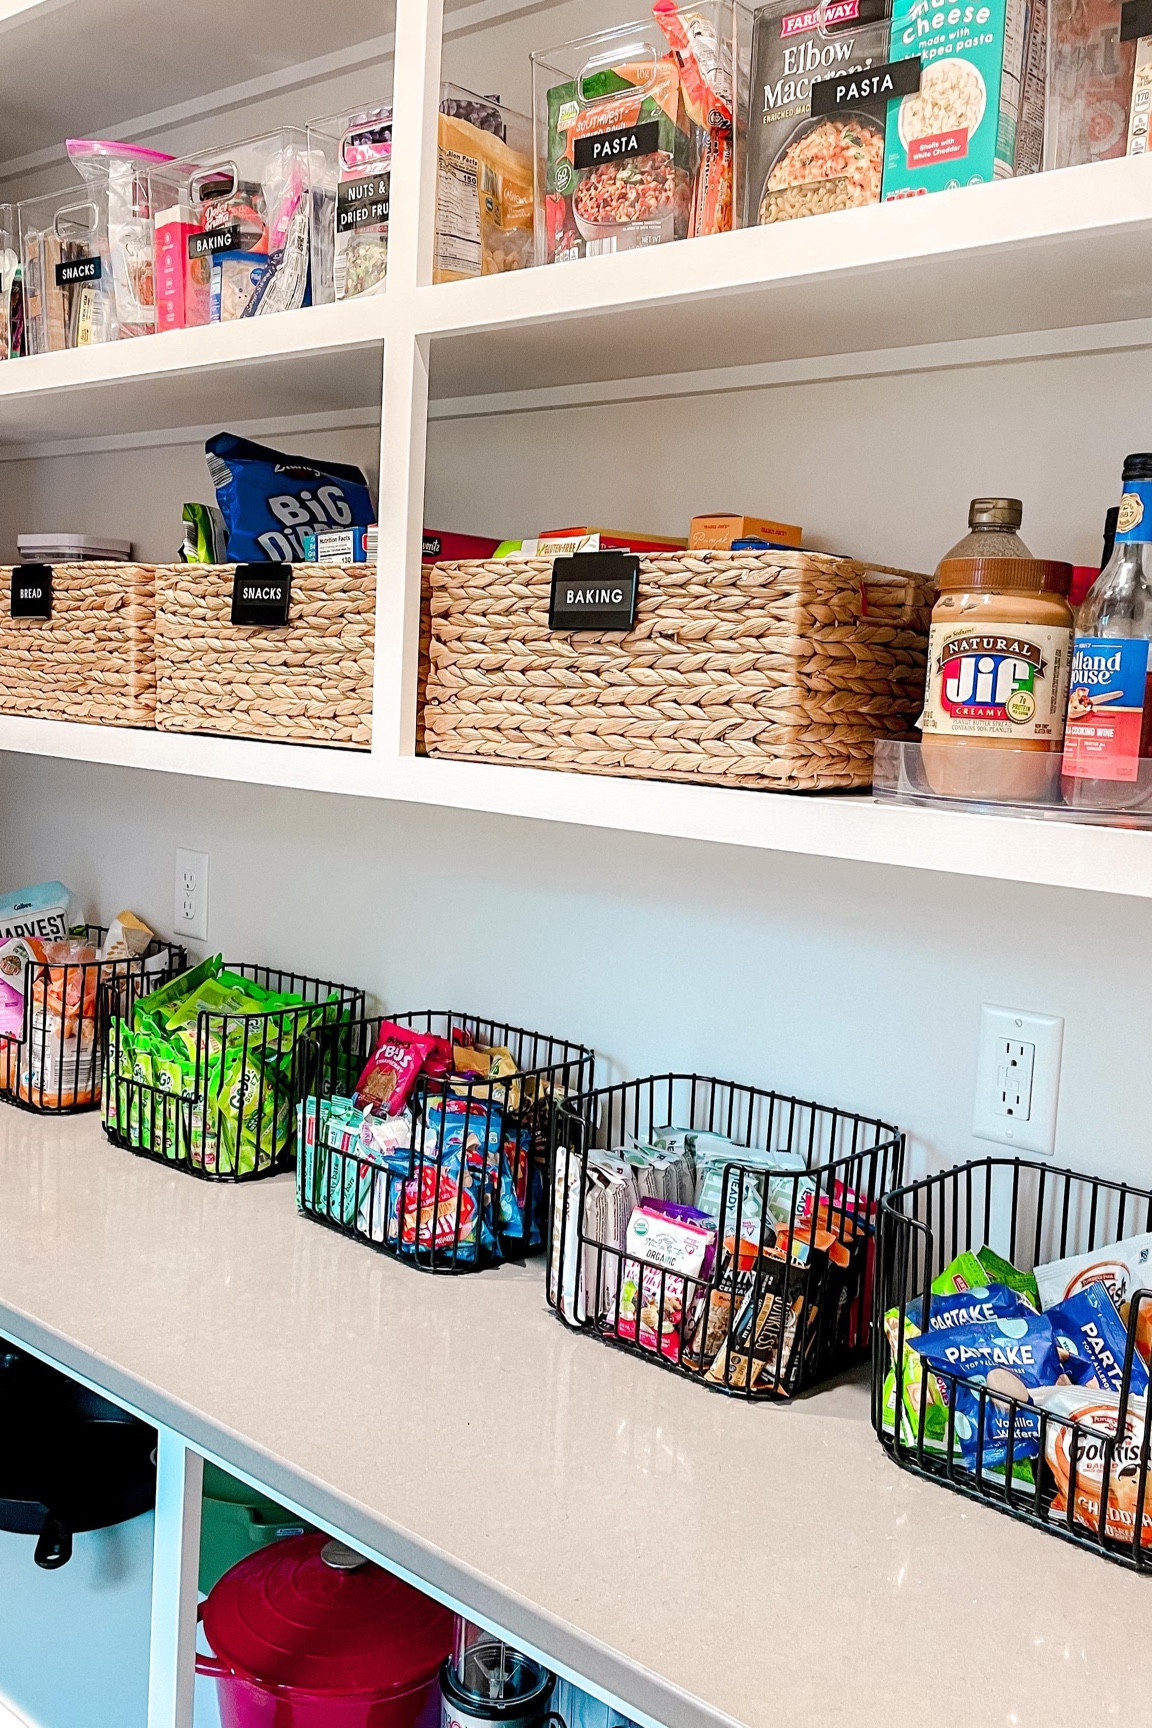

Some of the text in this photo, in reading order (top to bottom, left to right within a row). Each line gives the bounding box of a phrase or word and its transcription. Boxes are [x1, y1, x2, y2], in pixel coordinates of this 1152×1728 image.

[902, 6, 991, 45] cheese
[918, 27, 970, 48] made with
[956, 33, 993, 53] pasta
[783, 39, 855, 76] Elbow
[836, 74, 894, 103] PASTA
[593, 135, 638, 158] PASTA
[919, 138, 955, 151] Shells with
[913, 145, 961, 161] White Cheddar
[463, 174, 477, 185] 150
[348, 181, 386, 200] NUTS &
[341, 208, 369, 226] DRIED
[196, 234, 232, 252] BAKING
[62, 264, 95, 280] SNACKS
[544, 543, 576, 555] GLUTEN-FREE
[20, 588, 42, 599] BREAD
[243, 587, 282, 600] SNACKS
[567, 589, 623, 604] BAKING
[949, 638, 1031, 656] NATURAL
[946, 657, 1029, 703] Jif
[1012, 703, 1031, 712] PROTEIN
[1020, 696, 1027, 704] 7g
[956, 708, 1003, 716] CREAMY
[1072, 726, 1095, 736] COOKING
[1097, 728, 1114, 738] WINE
[0, 914, 65, 938] ARVEST
[646, 1250, 676, 1267] ORGANIC
[930, 1303, 998, 1330] PARTAKE
[1082, 1340, 1092, 1354] TOP
[995, 1417, 1033, 1428] Vailla
[997, 1428, 1039, 1440] Wfers
